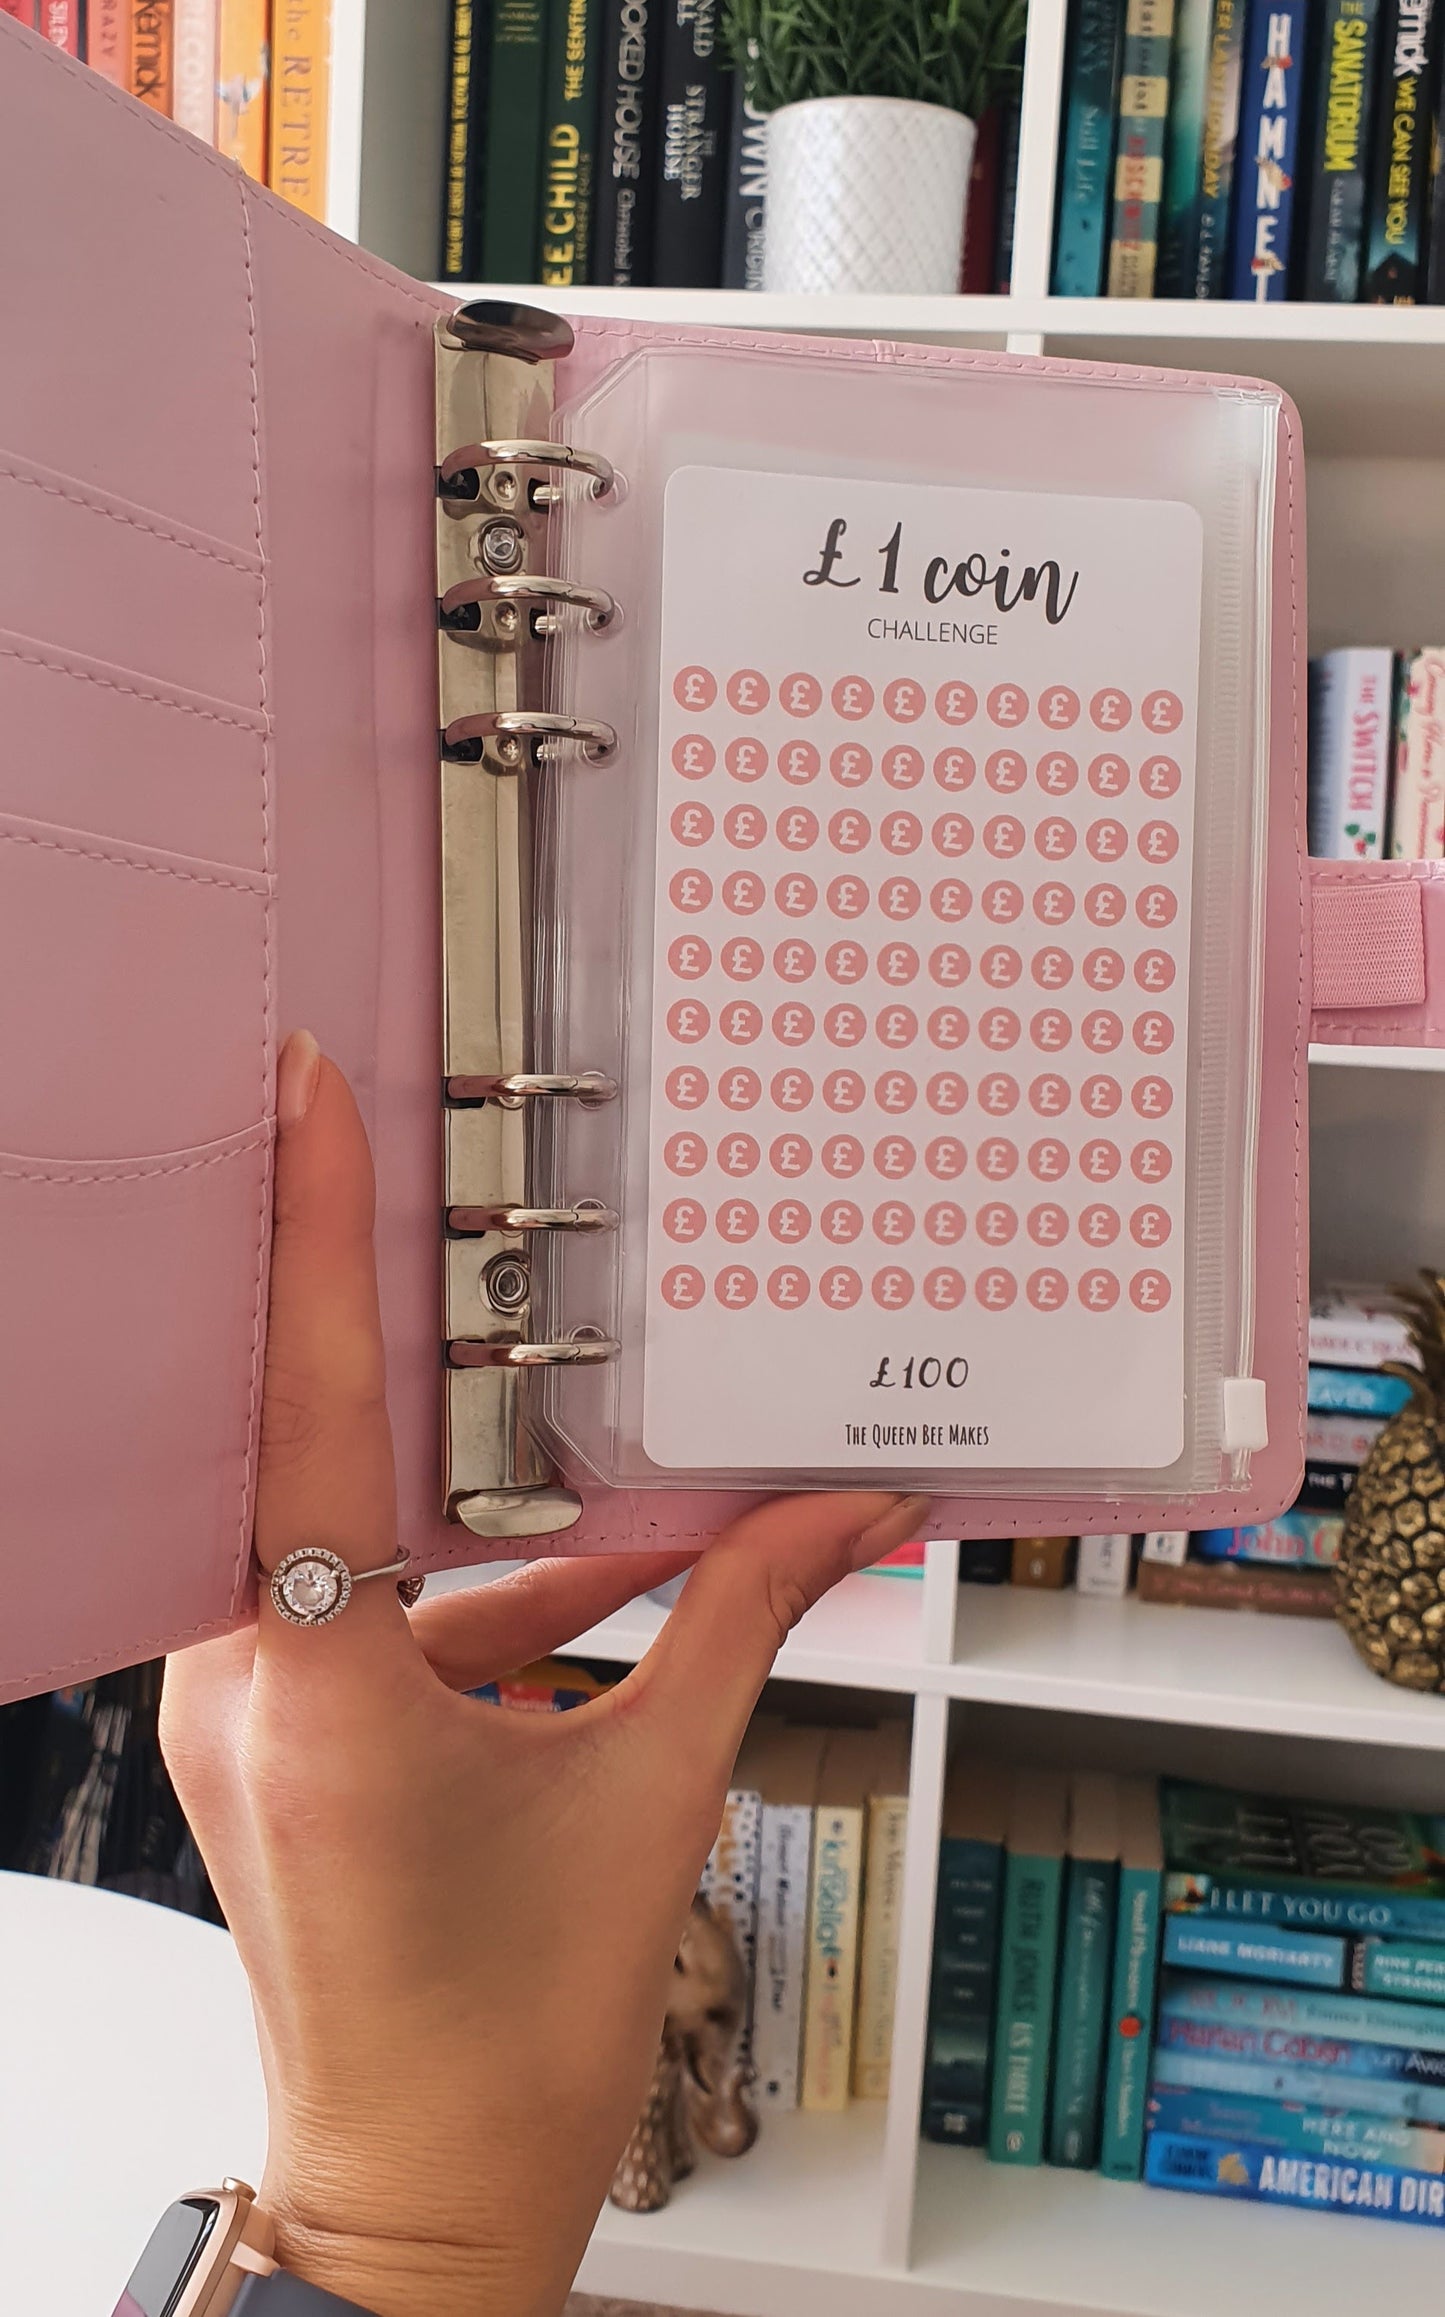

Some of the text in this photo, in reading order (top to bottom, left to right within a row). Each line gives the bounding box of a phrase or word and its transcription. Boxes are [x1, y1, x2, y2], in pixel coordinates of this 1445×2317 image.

[564, 65, 584, 101] THE
[1322, 18, 1368, 172] SANATORIUM
[1394, 76, 1418, 112] WE
[611, 83, 644, 181] HOUSE
[664, 103, 687, 182] HOUSE
[681, 84, 707, 201] STRANGER
[1391, 113, 1416, 162] CAN
[545, 123, 580, 235] CHILD
[1251, 12, 1292, 303] HAMNET
[1388, 163, 1412, 199] SEE
[1385, 201, 1409, 246] YOU
[543, 241, 574, 287] EE
[802, 518, 1080, 625] £ 1 coin
[866, 617, 999, 646] CHALLENGE
[683, 673, 1172, 728] £ £ £ £ £ £ £ £ £ £
[1348, 710, 1380, 812] SWITCH
[680, 808, 1168, 858] £ £ £ £ £ £ £ £ £ £
[679, 941, 1164, 986] £ £ £ £ £ £ £ £ £ £
[675, 1072, 1161, 1113] £ £ £ £ £ £ £ £ £ £
[672, 1205, 1159, 1241] £ £ £ £ £ £ £ £ £ £
[868, 1355, 970, 1390] £100
[1226, 1889, 1276, 1916] LET
[1283, 1897, 1343, 1921] YOU
[1348, 1904, 1392, 1926] GO
[1177, 1936, 1232, 1957] LIANE
[1237, 1942, 1335, 1970] MORIARTY
[1169, 2018, 1258, 2053] Harlan
[1262, 2027, 1353, 2065] Coben
[1302, 2116, 1358, 2140] HERE
[1322, 2140, 1384, 2163] NOW
[1258, 2155, 1395, 2210] AMERICAN
